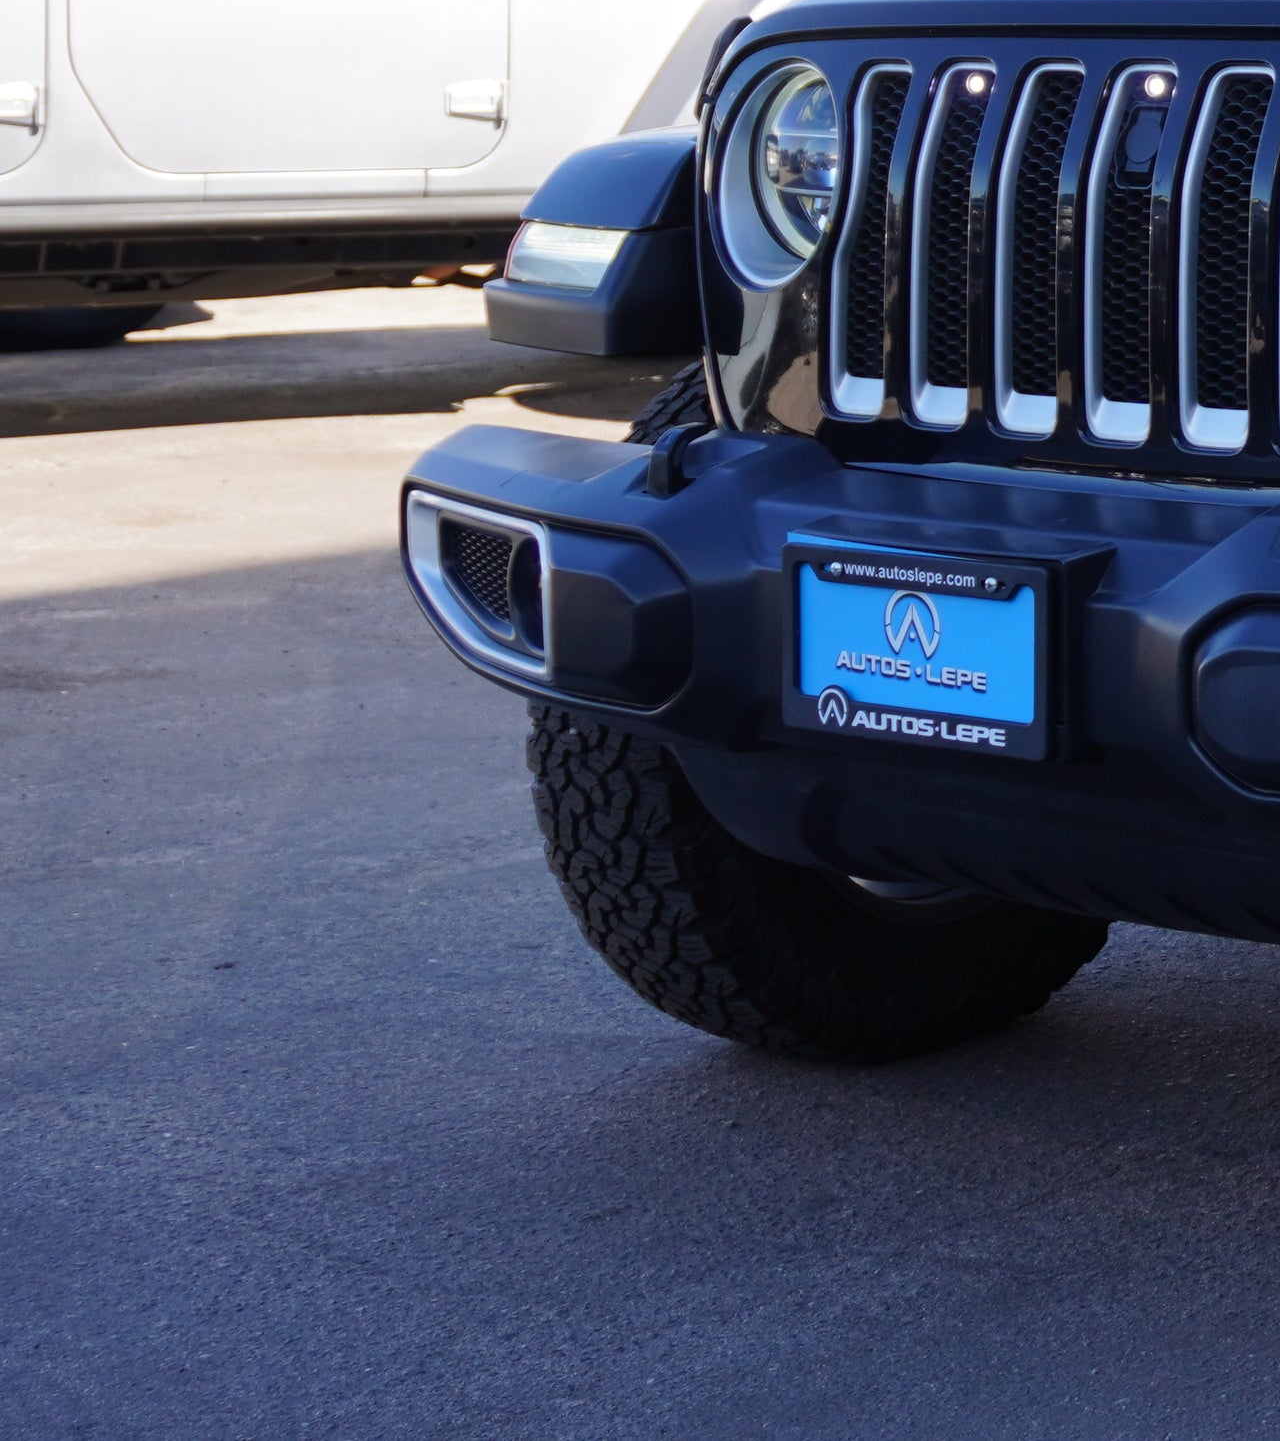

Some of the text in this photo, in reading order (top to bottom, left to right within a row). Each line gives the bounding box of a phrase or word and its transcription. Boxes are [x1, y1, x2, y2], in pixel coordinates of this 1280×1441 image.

[843, 562, 976, 589] www.autoslepe.com
[836, 650, 987, 692] AUTOS LEPE
